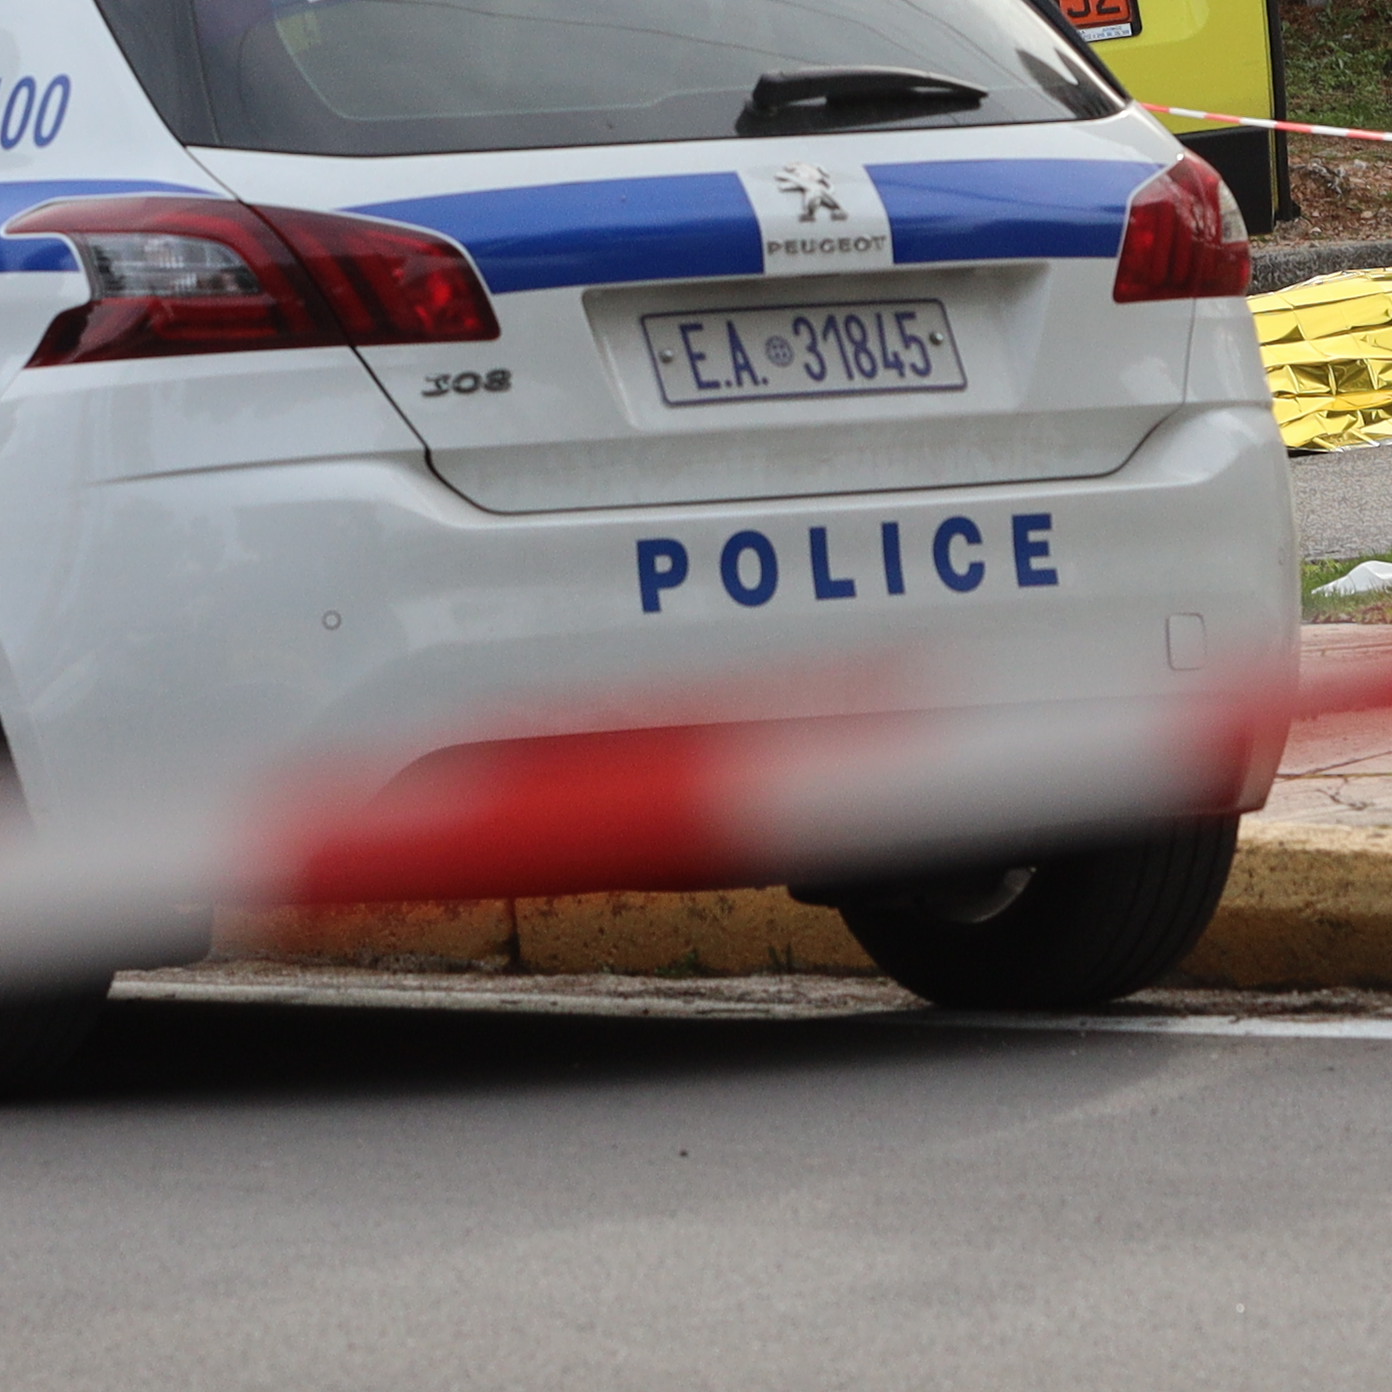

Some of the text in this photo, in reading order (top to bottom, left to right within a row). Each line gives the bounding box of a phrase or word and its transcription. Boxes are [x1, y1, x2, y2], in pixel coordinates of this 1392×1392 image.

[767, 234, 887, 256] PEUGEOT
[792, 311, 932, 382] 31845
[421, 369, 512, 398] 308
[636, 512, 1060, 613] POLICE
